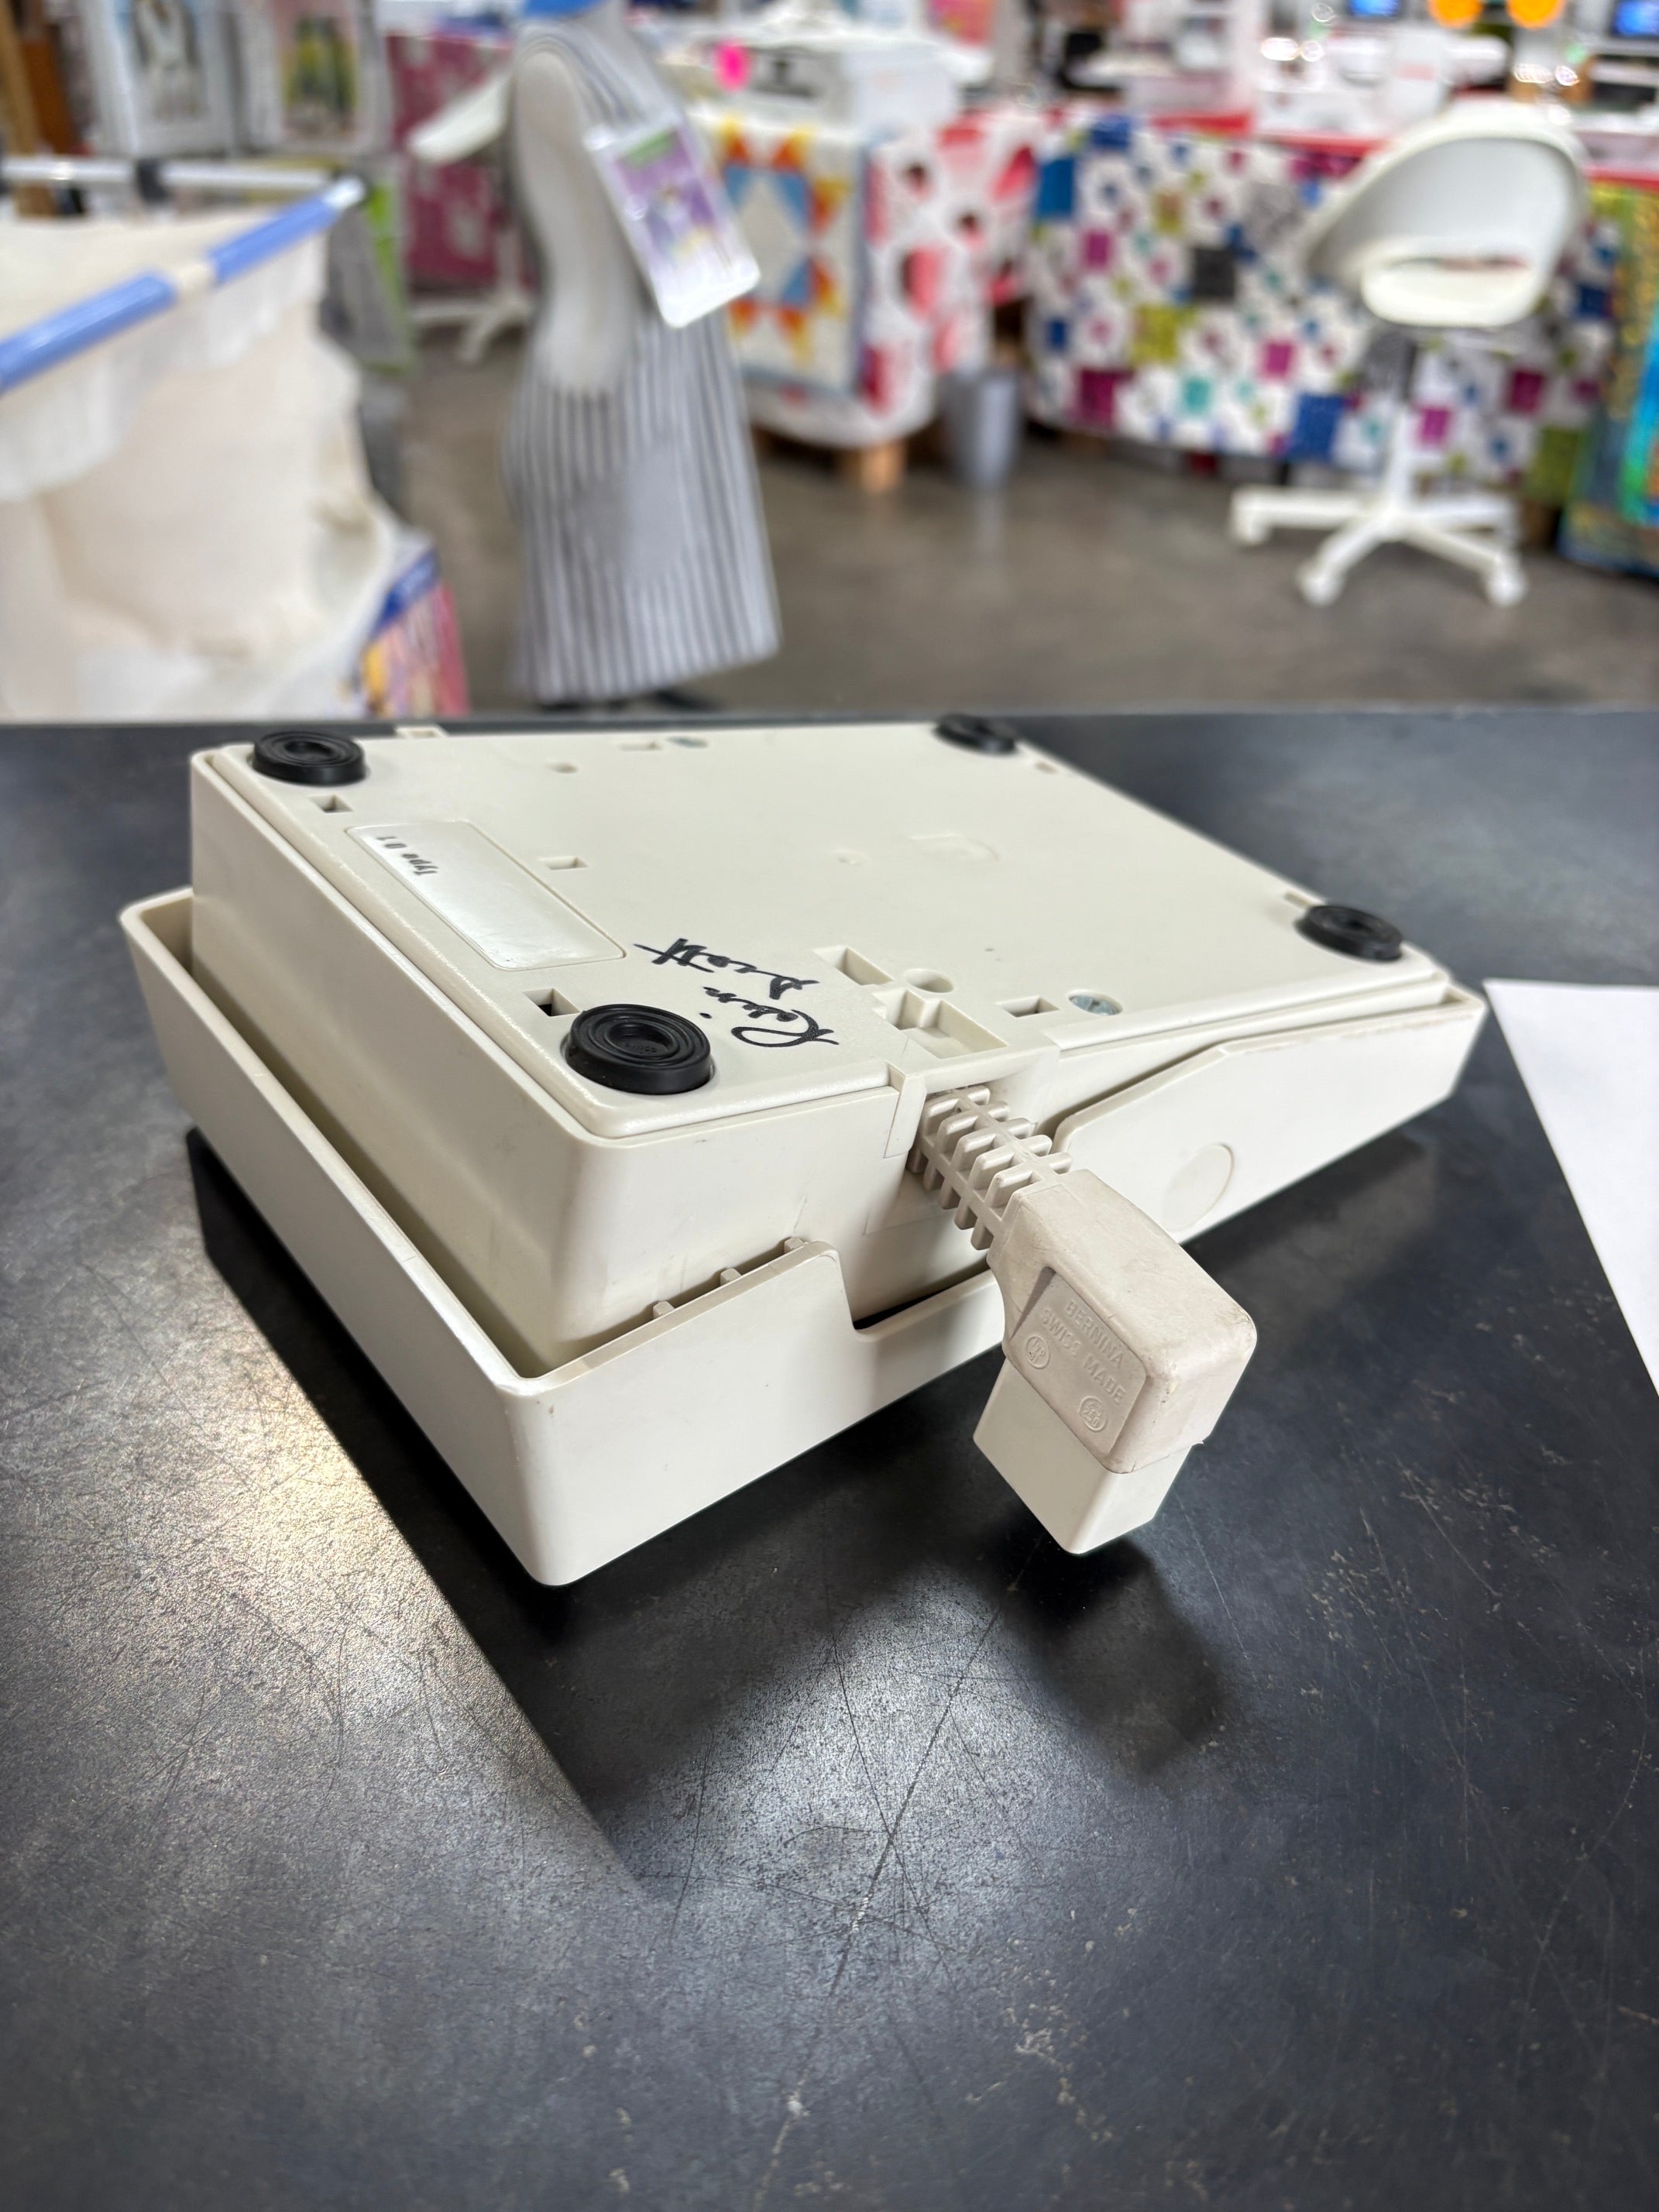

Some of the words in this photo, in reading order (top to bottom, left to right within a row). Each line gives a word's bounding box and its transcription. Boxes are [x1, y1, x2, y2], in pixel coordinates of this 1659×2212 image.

[401, 854, 439, 876] Type
[1041, 1307, 1081, 1358] SWISS
[1084, 1355, 1126, 1406] MADE
[1066, 1301, 1123, 1369] BERNINA
